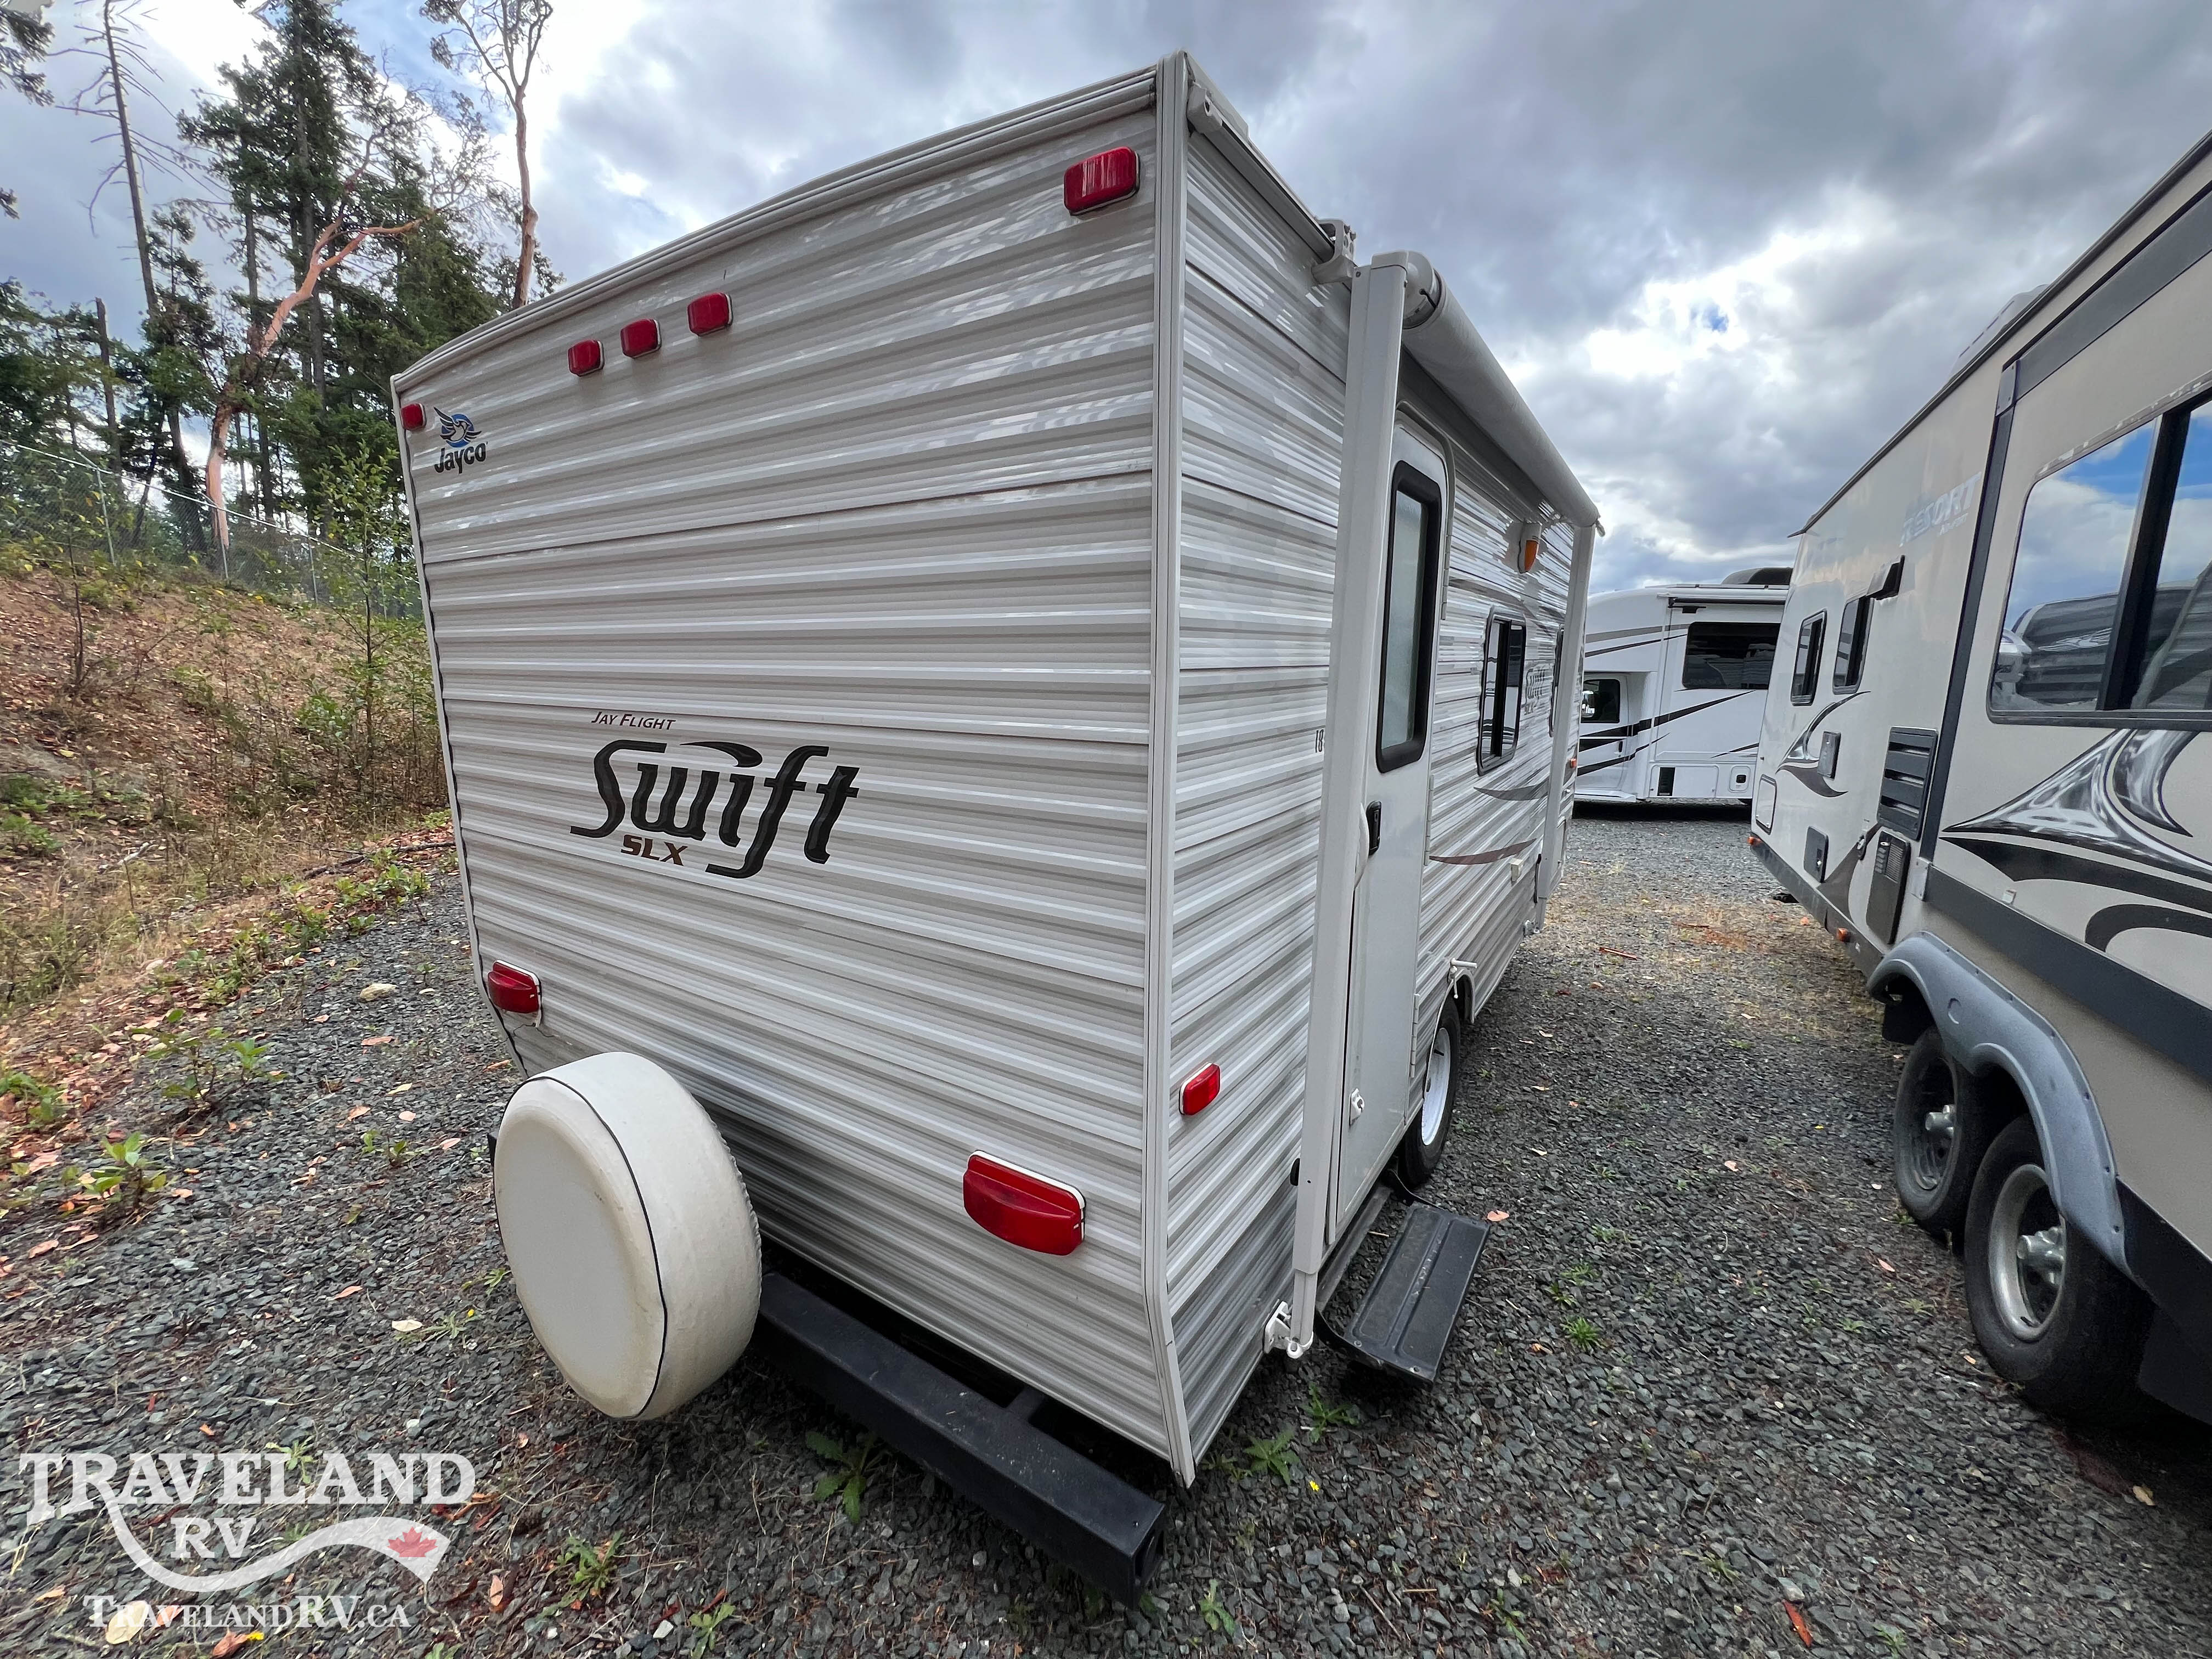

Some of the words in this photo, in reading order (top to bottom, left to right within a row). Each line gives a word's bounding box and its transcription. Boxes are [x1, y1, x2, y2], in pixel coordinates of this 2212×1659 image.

[434, 442, 486, 474] Jayco
[570, 740, 860, 879] Swift
[620, 834, 689, 866] SLX
